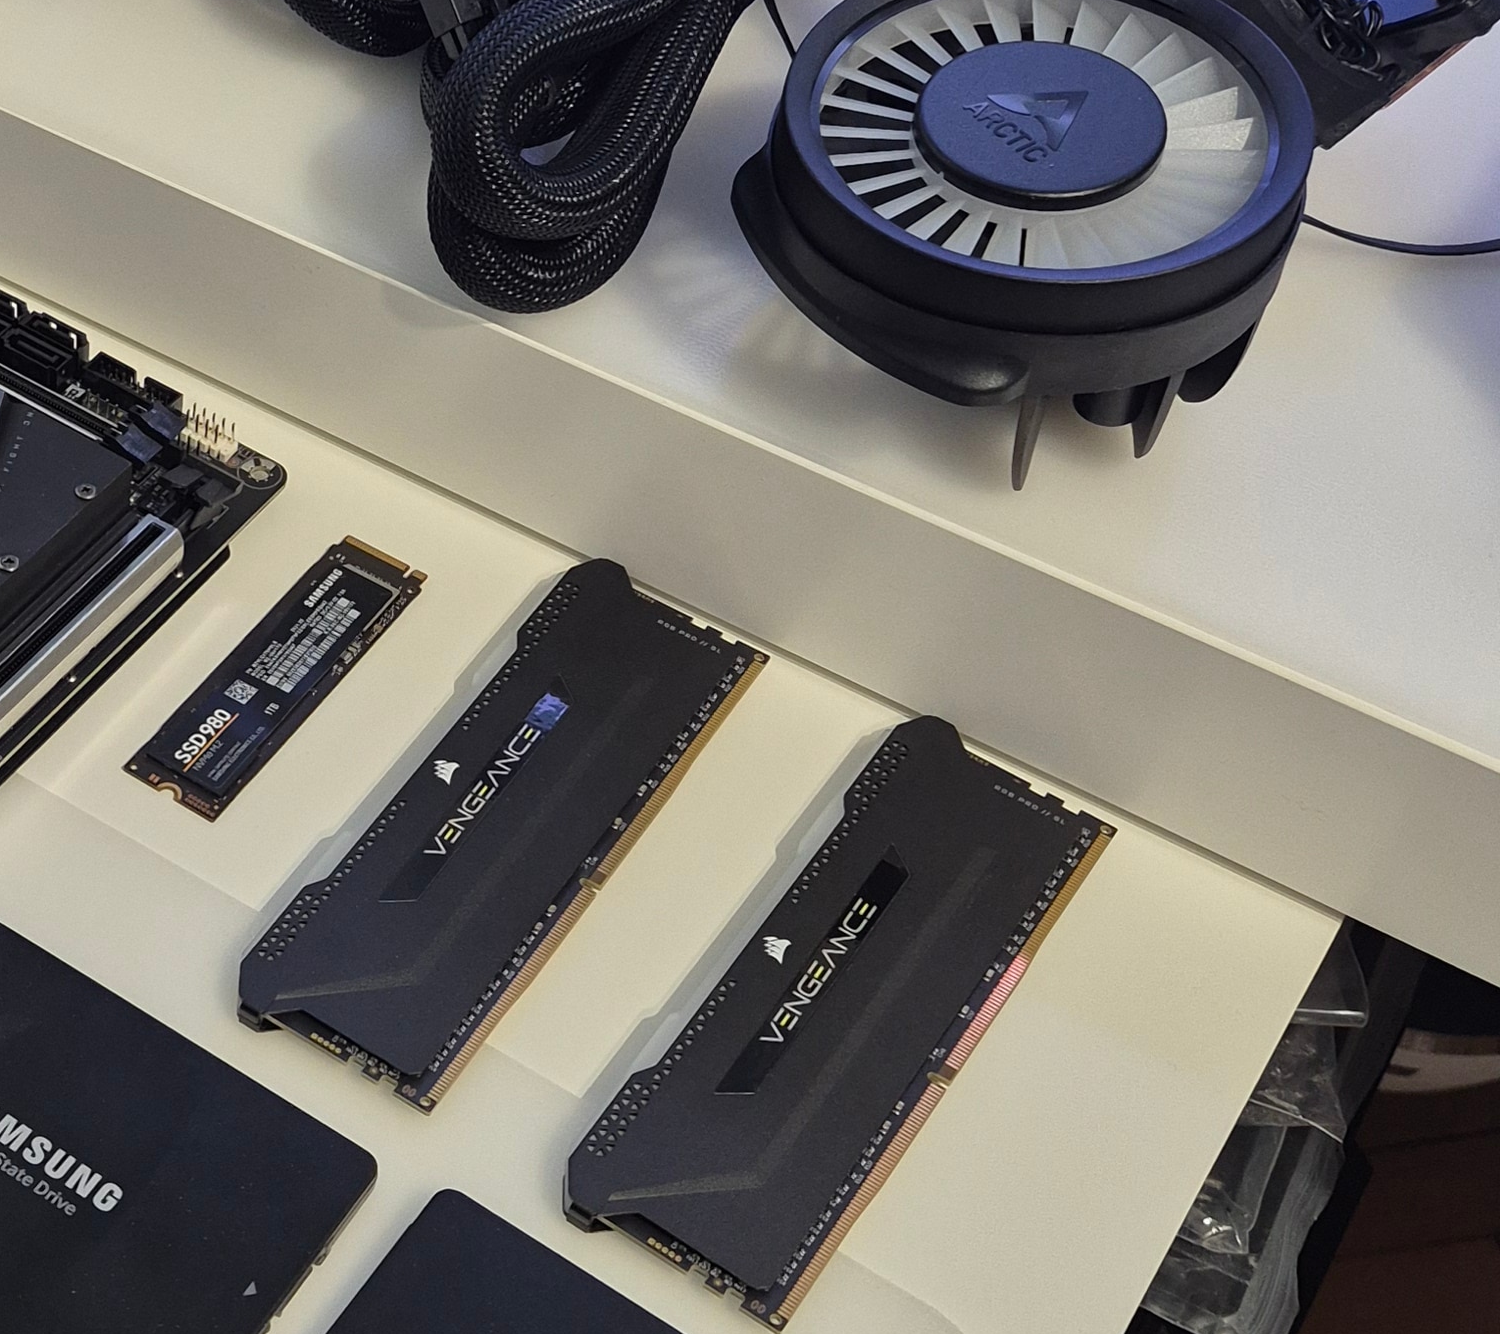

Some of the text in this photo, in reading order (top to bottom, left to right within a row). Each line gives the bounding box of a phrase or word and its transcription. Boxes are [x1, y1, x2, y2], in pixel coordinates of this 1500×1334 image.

[962, 101, 1048, 163] ARCTIC
[303, 568, 343, 607] SAMSUNG
[264, 702, 280, 716] 1TB
[423, 723, 541, 857] VENGEANCE
[760, 897, 877, 1045] VENGEANCE
[32, 1179, 77, 1216] Drive
